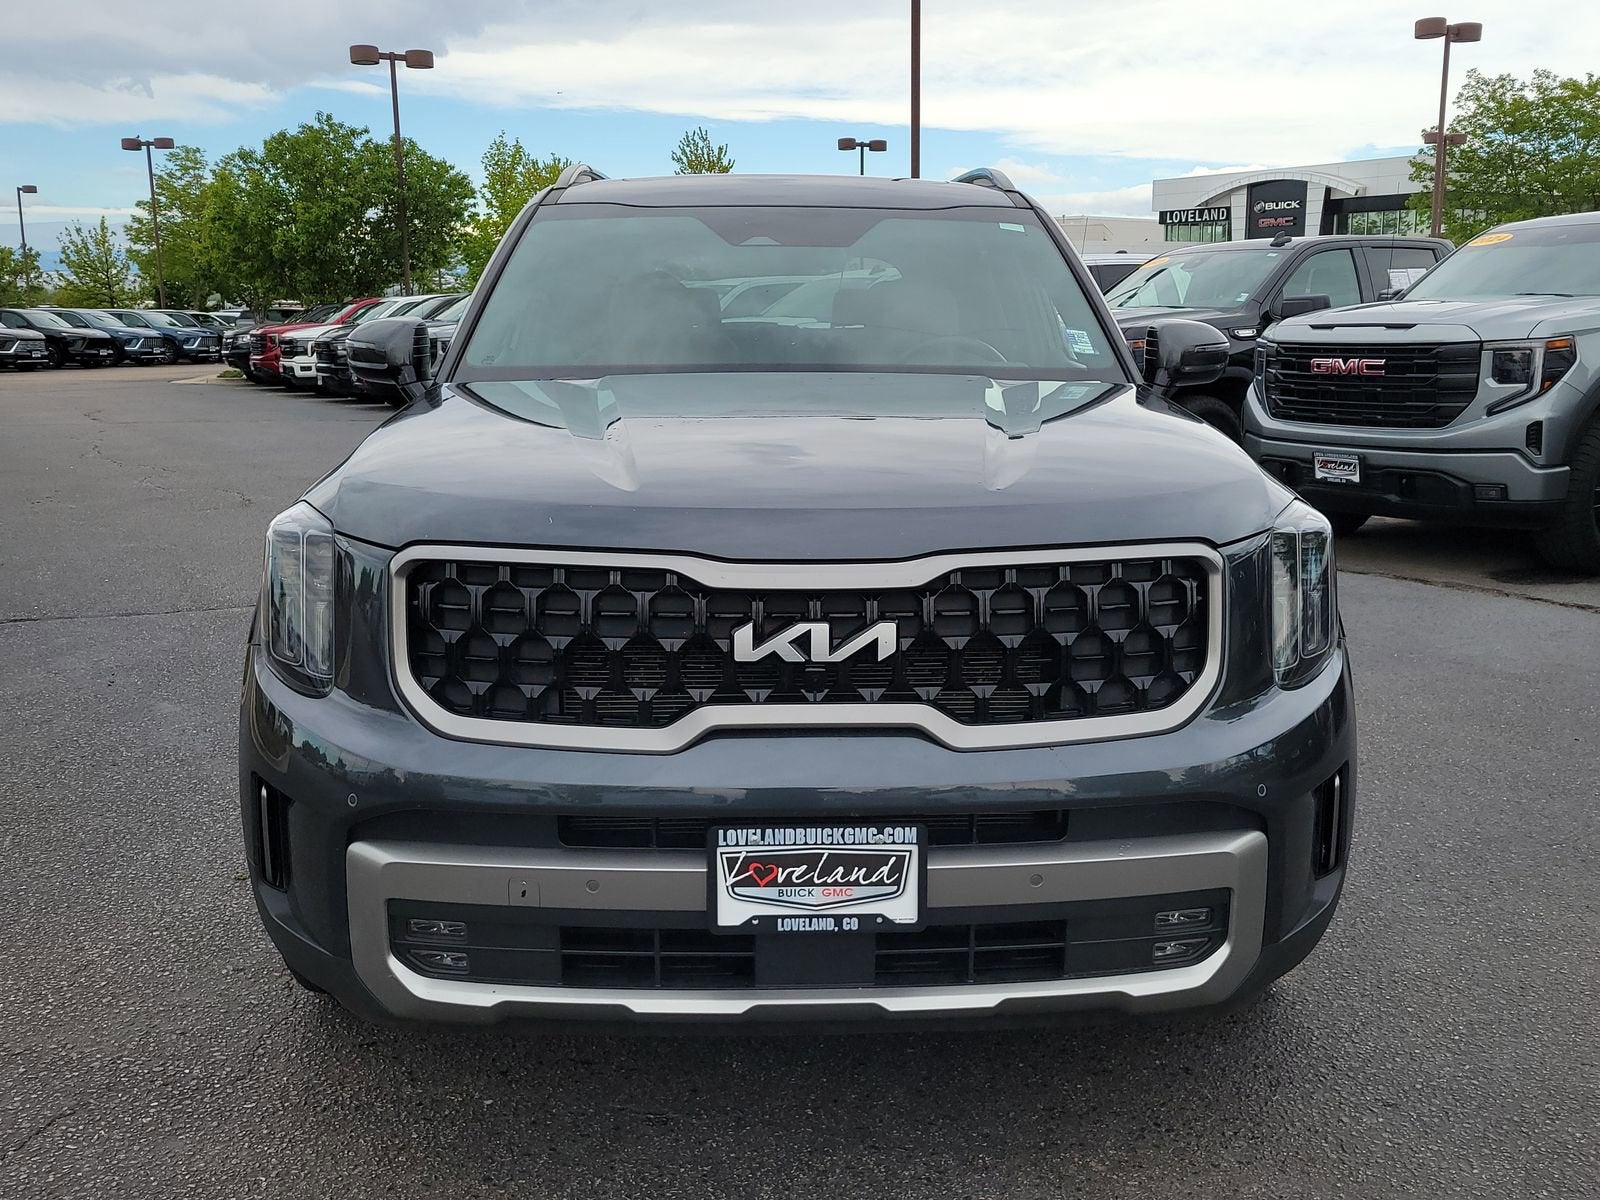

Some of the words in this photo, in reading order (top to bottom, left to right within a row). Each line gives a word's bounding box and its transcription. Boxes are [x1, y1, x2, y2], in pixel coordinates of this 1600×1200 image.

[1265, 200, 1300, 211] BUICK
[1166, 208, 1227, 223] LOVELAND
[1258, 217, 1293, 227] GMC
[1311, 358, 1385, 375] GMC
[734, 622, 897, 662] KIA
[718, 827, 917, 845] LOVELANDBUICKGMCCOM
[777, 888, 815, 898] BUICK
[821, 888, 854, 897] GMC
[777, 918, 839, 932] LOVELAND,
[843, 918, 858, 930] CO
